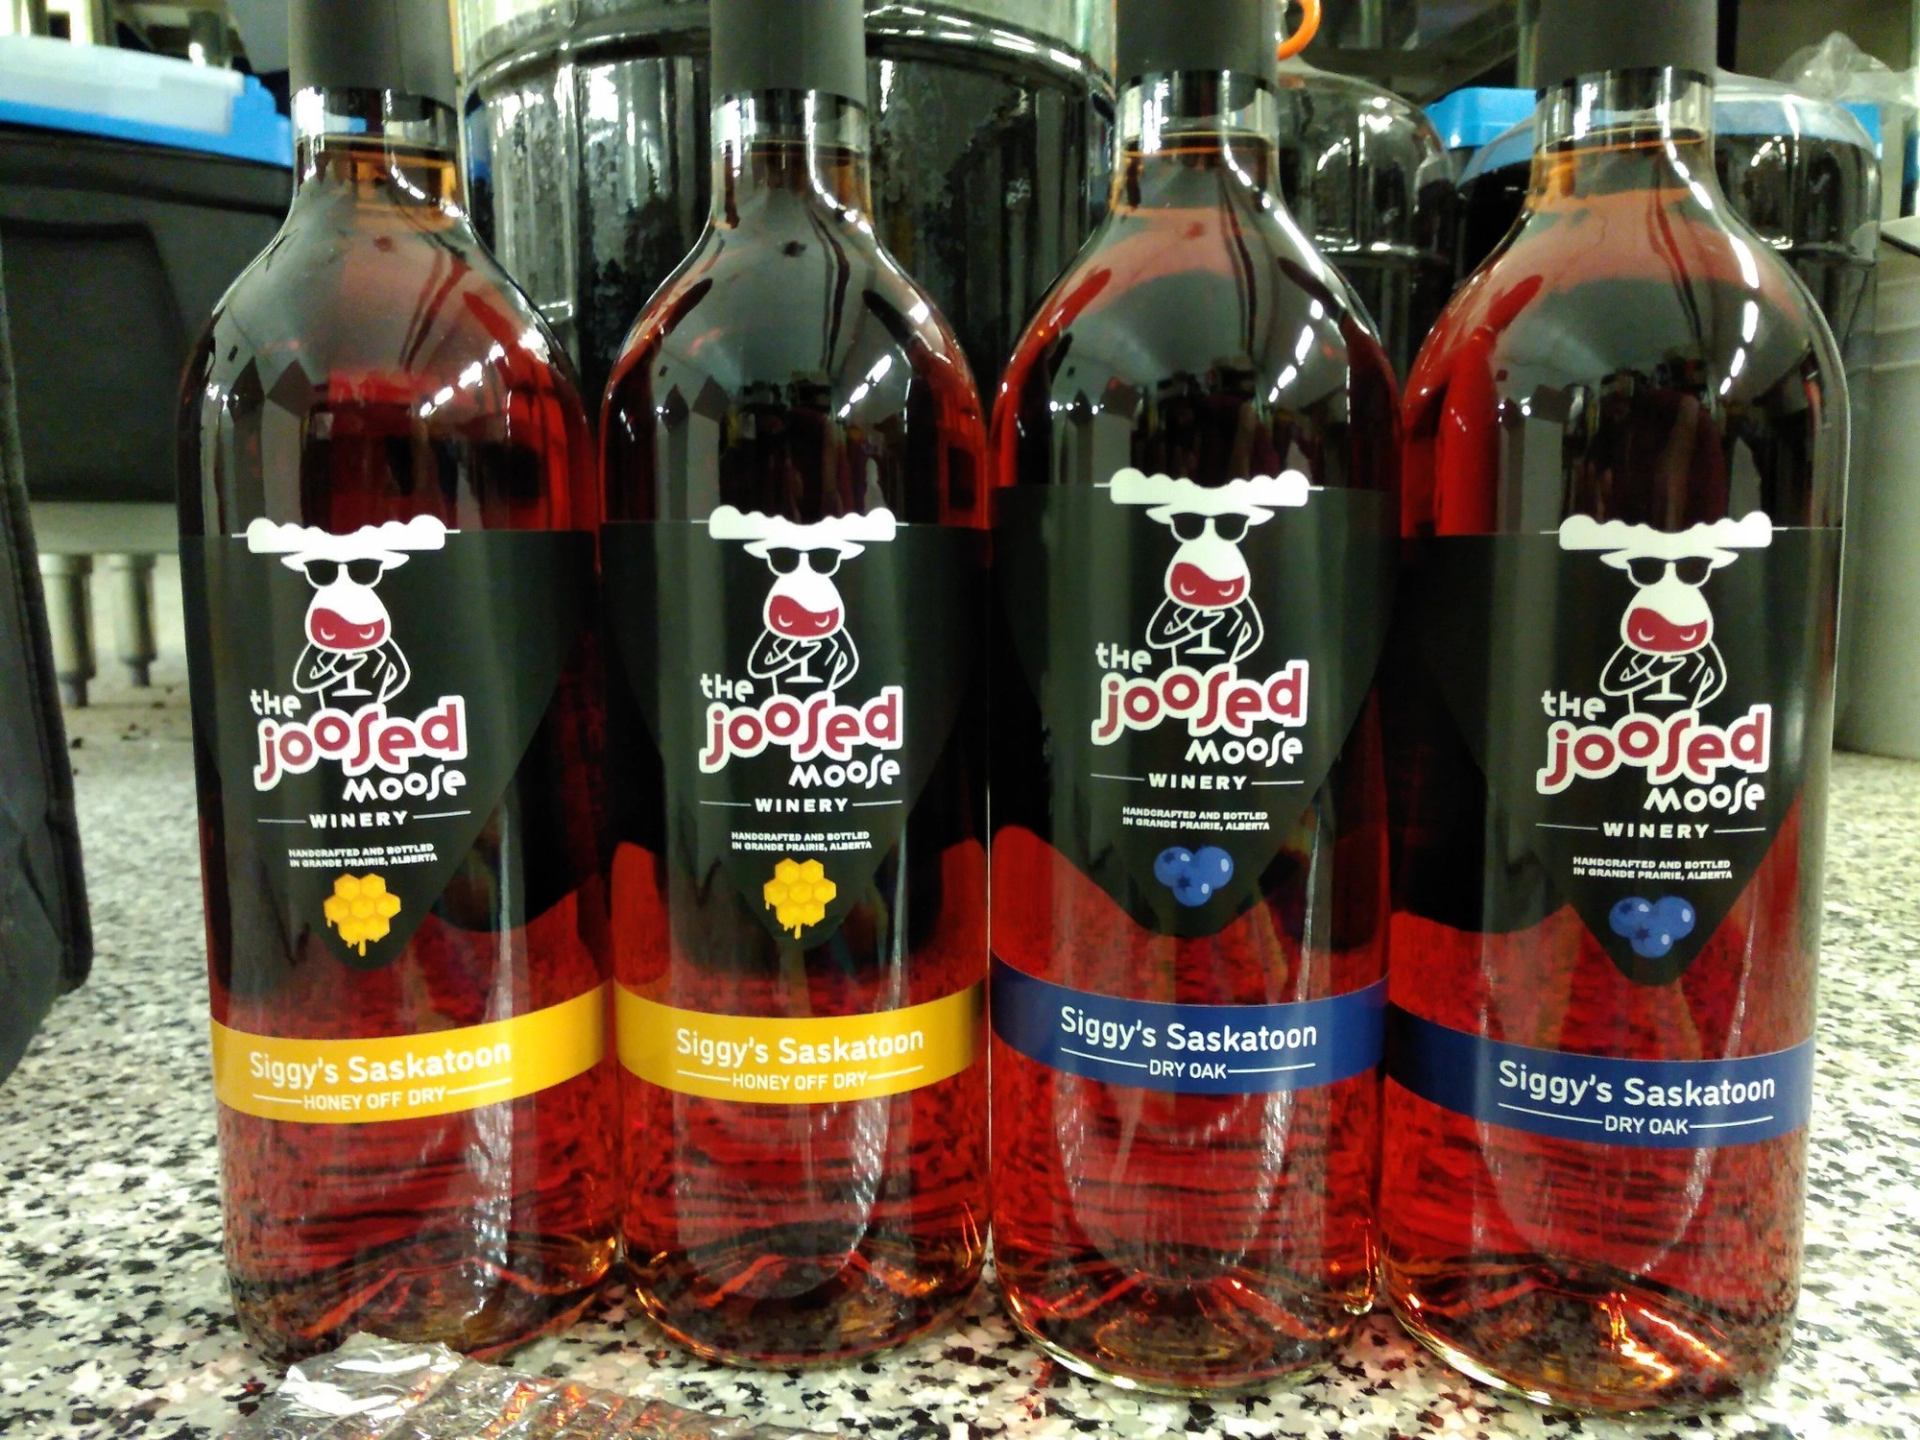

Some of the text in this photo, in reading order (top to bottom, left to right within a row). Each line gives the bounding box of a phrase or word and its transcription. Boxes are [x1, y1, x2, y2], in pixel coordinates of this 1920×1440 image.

[1149, 773, 1248, 790] WINERY
[755, 798, 848, 812] WINERY
[310, 811, 408, 829] WINERY
[1123, 807, 1268, 820] HANDCRAFTED AND BOTTLED
[1123, 817, 1270, 831] IN GRANDE PRAIRIE, ALBERTA
[1603, 822, 1710, 838] WINERY
[731, 832, 870, 841] HANDCRAFTED AND BOTTLED
[288, 843, 434, 858] HANDCRAFTED AND BOTTLED
[745, 842, 784, 850] GRANDE
[786, 843, 828, 851] PRAIRIE,
[830, 841, 872, 850] ALBERTA
[290, 854, 438, 867] IN GRANDE PRAIRIE, ALBERTA
[1573, 857, 1731, 869] HANDCRAFTED AND BOTTLED
[1573, 867, 1732, 881] IN GRANDE PRAIRIE, ALBERTA
[1061, 1006, 1317, 1052] Siggy's Saskatoon
[677, 1028, 924, 1069] Siggy's Saskatoon
[250, 1042, 511, 1090] Siggy's Saskatoon
[1149, 1059, 1227, 1079] DRY OAK
[732, 1072, 868, 1090] HONEY OFF DRY
[1499, 1060, 1775, 1107] Siggy's Saskatoon
[304, 1087, 446, 1110] HONEY OFF DRY
[1605, 1115, 1688, 1135] DRY OAK
